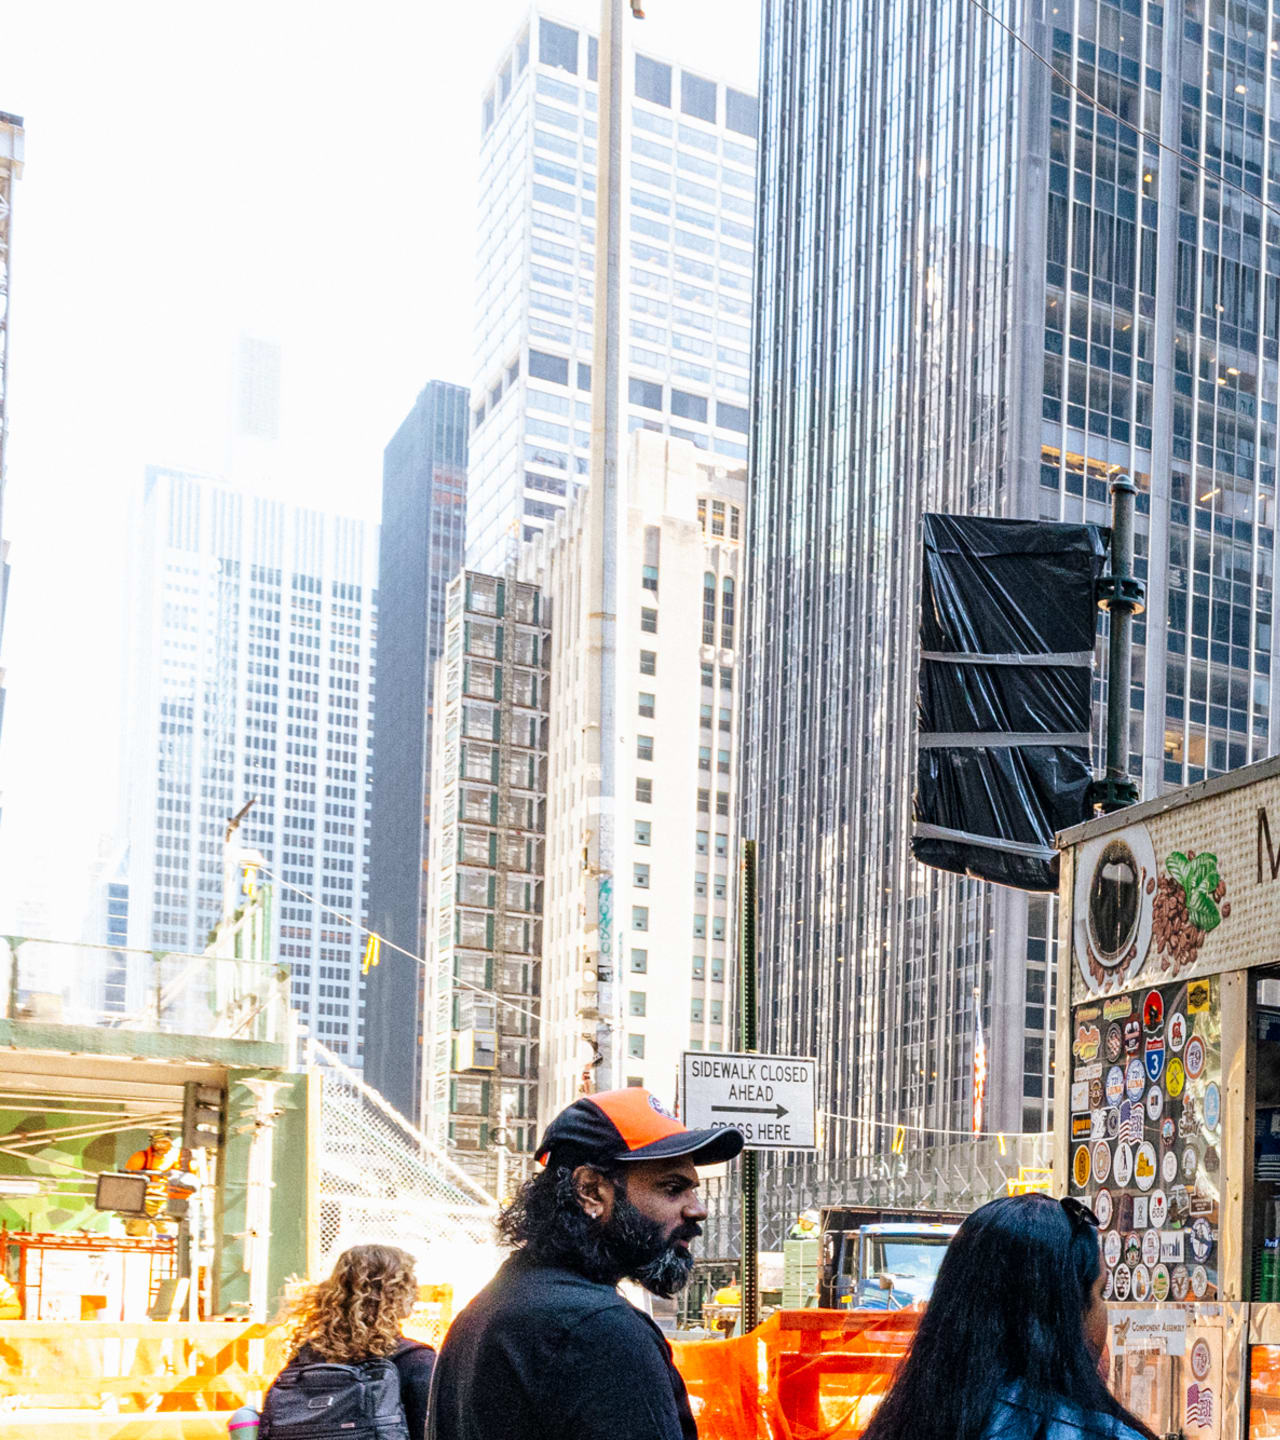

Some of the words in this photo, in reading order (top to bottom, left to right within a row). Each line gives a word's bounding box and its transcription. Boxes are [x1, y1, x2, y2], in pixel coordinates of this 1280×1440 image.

[692, 1060, 757, 1080] SIDEWALK
[761, 1065, 808, 1083] CLOSED
[728, 1084, 774, 1101] AHEAD
[757, 1123, 792, 1141] HERE
